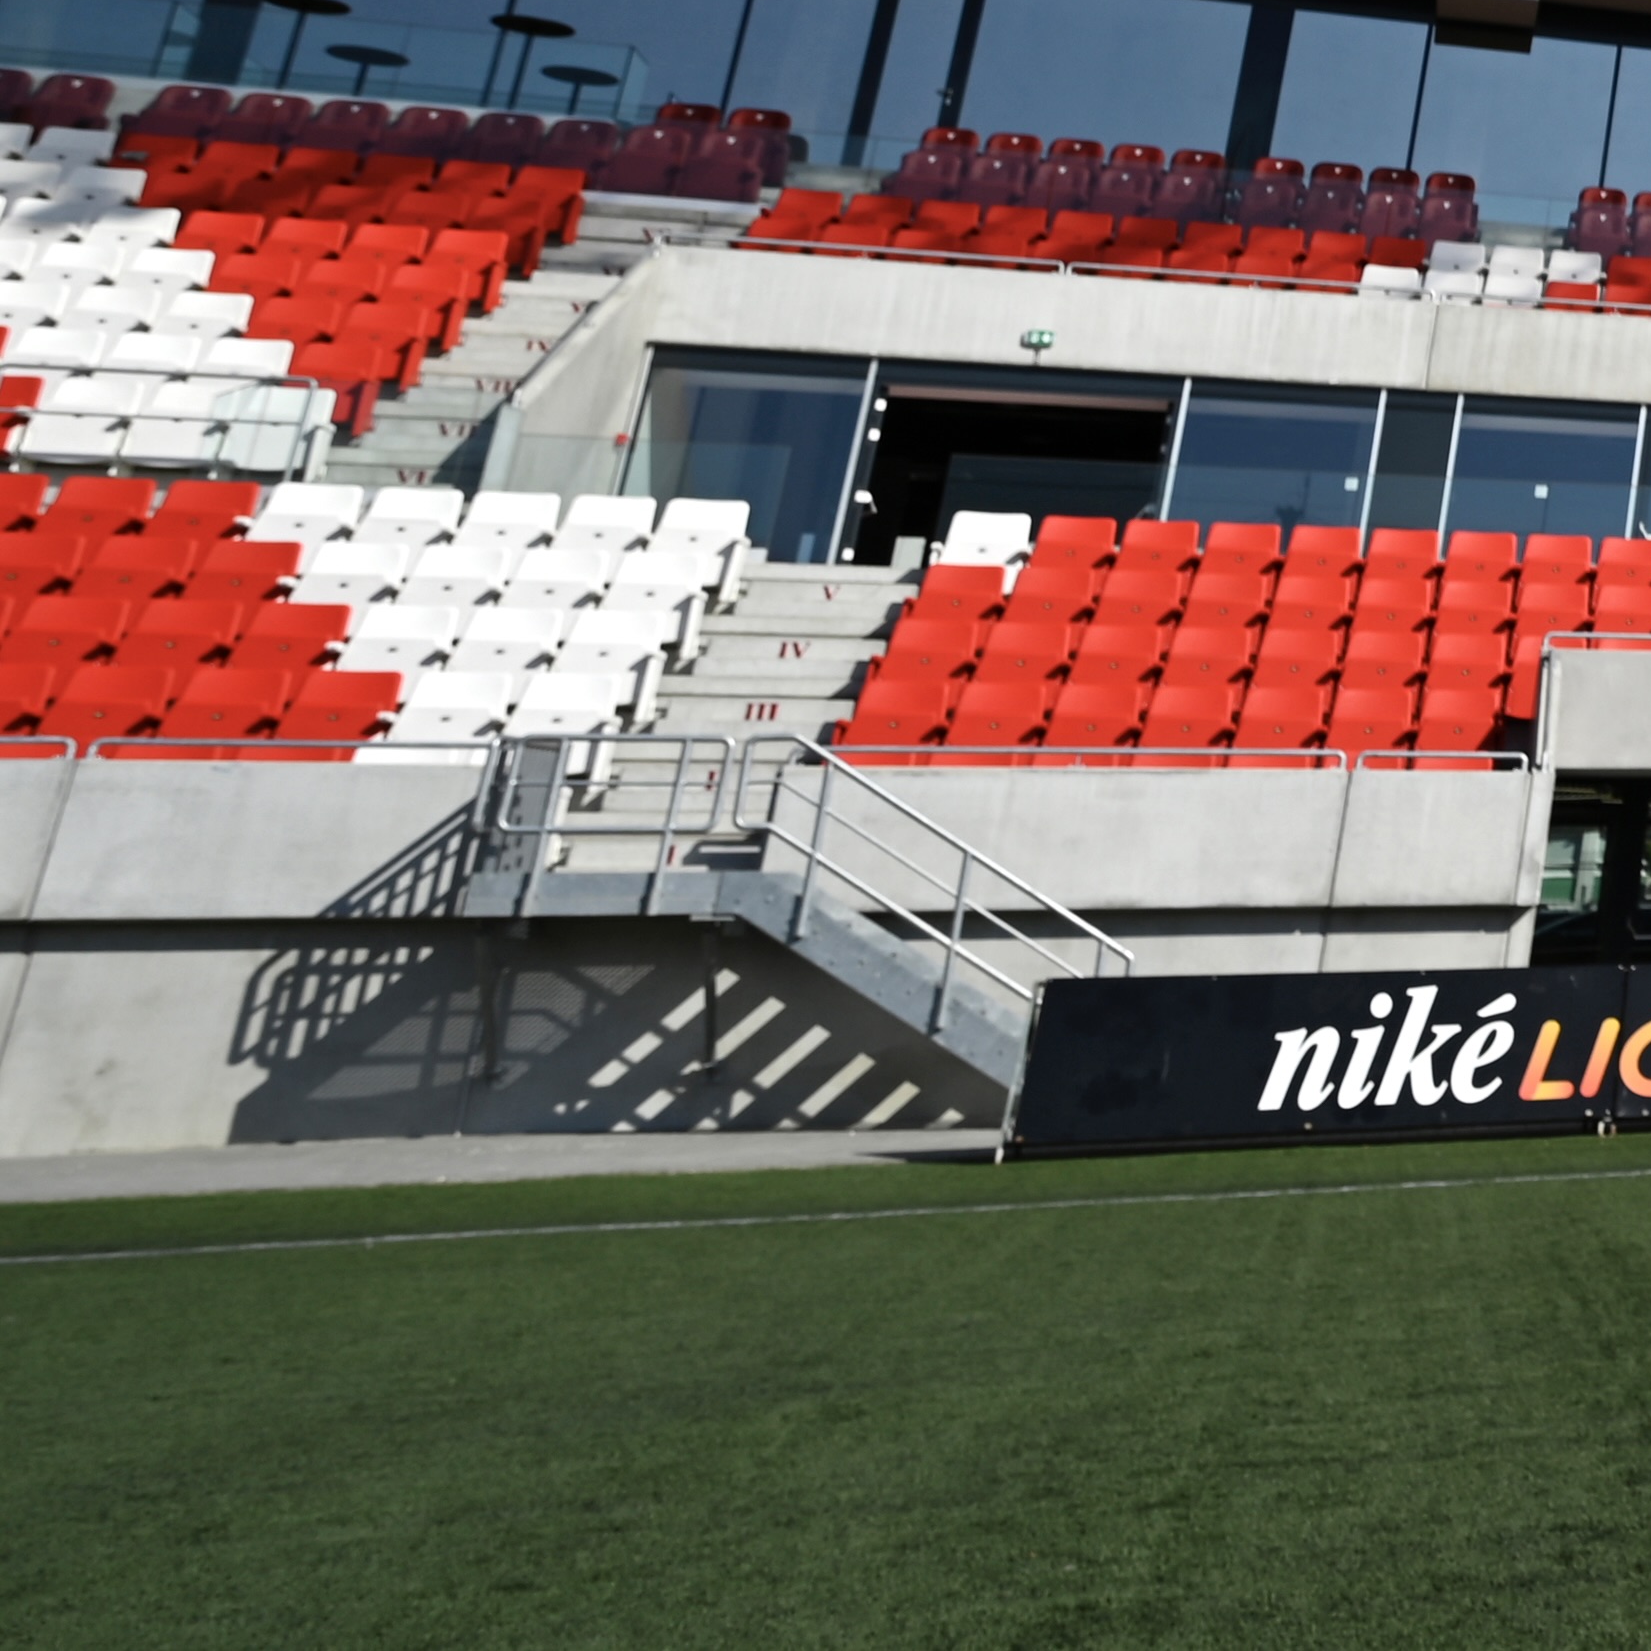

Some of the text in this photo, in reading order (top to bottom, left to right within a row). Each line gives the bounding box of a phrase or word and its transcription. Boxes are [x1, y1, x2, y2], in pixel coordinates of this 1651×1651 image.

[778, 641, 811, 659] IV
[744, 703, 780, 721] III
[1257, 984, 1517, 1111] niké
